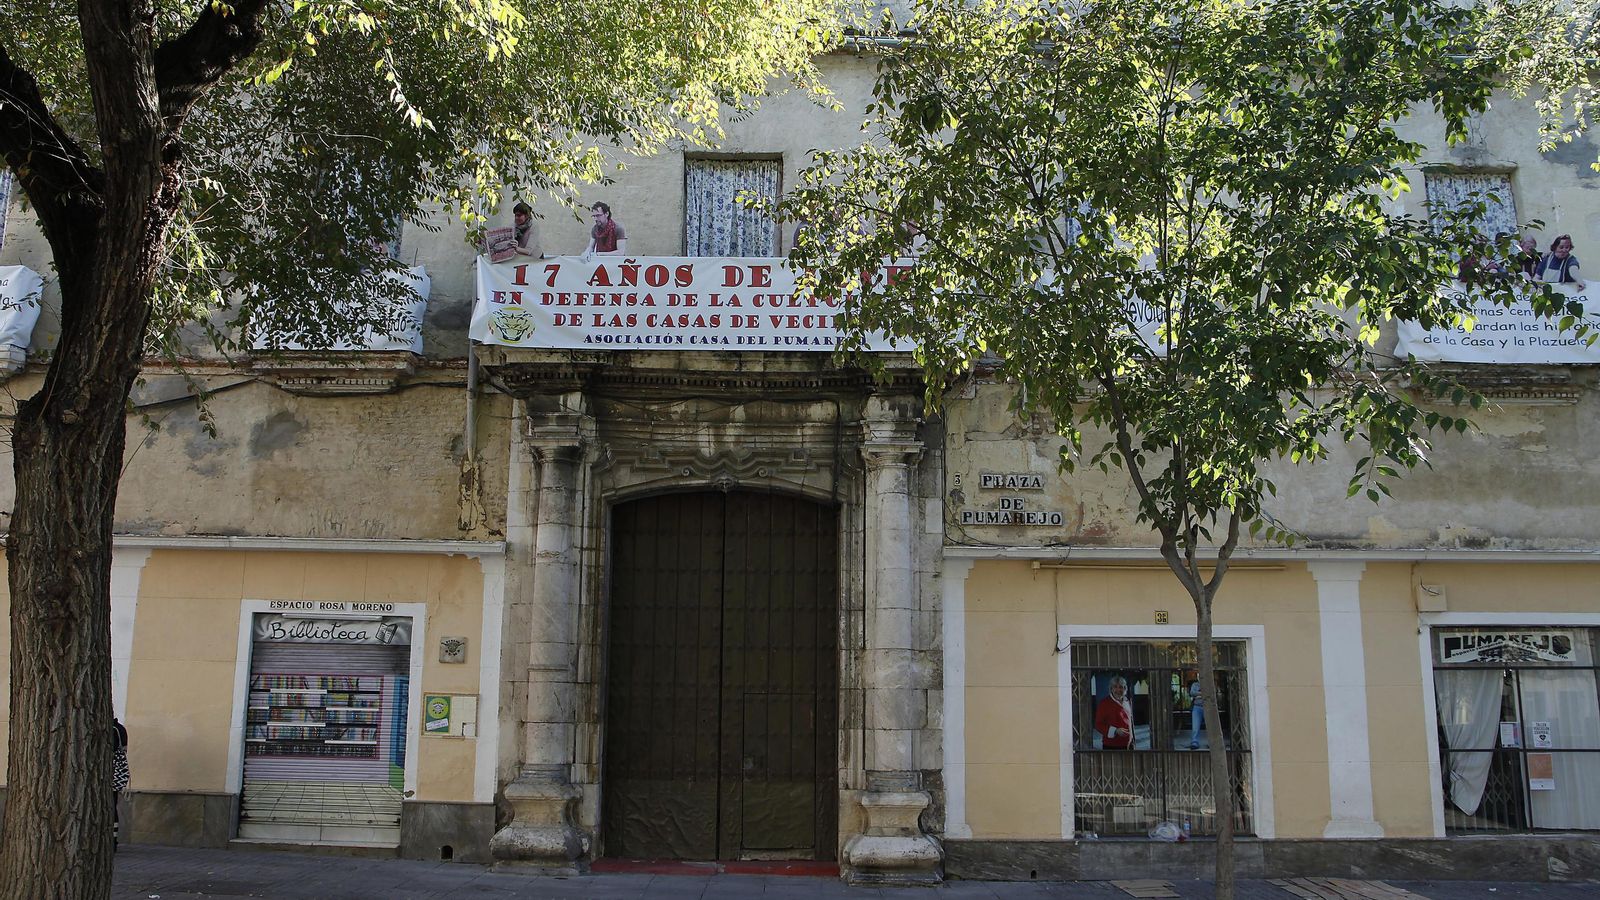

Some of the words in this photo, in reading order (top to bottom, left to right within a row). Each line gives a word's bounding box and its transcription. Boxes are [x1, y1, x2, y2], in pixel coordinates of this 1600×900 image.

[586, 258, 694, 288] AÑOS
[721, 265, 772, 288] DE
[491, 290, 524, 305] EN
[539, 293, 656, 307] DEFENSA
[667, 293, 699, 307] DE
[708, 293, 743, 307] LA
[553, 313, 583, 327] DE
[592, 313, 638, 328] LAS
[646, 314, 721, 328] CASAS
[730, 315, 760, 328] DE
[769, 315, 841, 329] VECI
[1457, 322, 1517, 334] gardan
[1521, 322, 1539, 331] las
[583, 333, 684, 345] ASOCIACIÓN
[690, 335, 730, 345] CASA
[737, 336, 767, 345] DEL
[1423, 335, 1440, 344] de
[1445, 336, 1457, 345] la
[1461, 337, 1495, 346] Casa
[1499, 339, 1508, 349] y
[1514, 336, 1526, 346] la
[983, 475, 1041, 488] PLAZA
[1001, 498, 1024, 511] DE
[270, 601, 313, 609] ESPACIO
[320, 602, 345, 610] ROSA
[270, 621, 368, 640] Biblioteca
